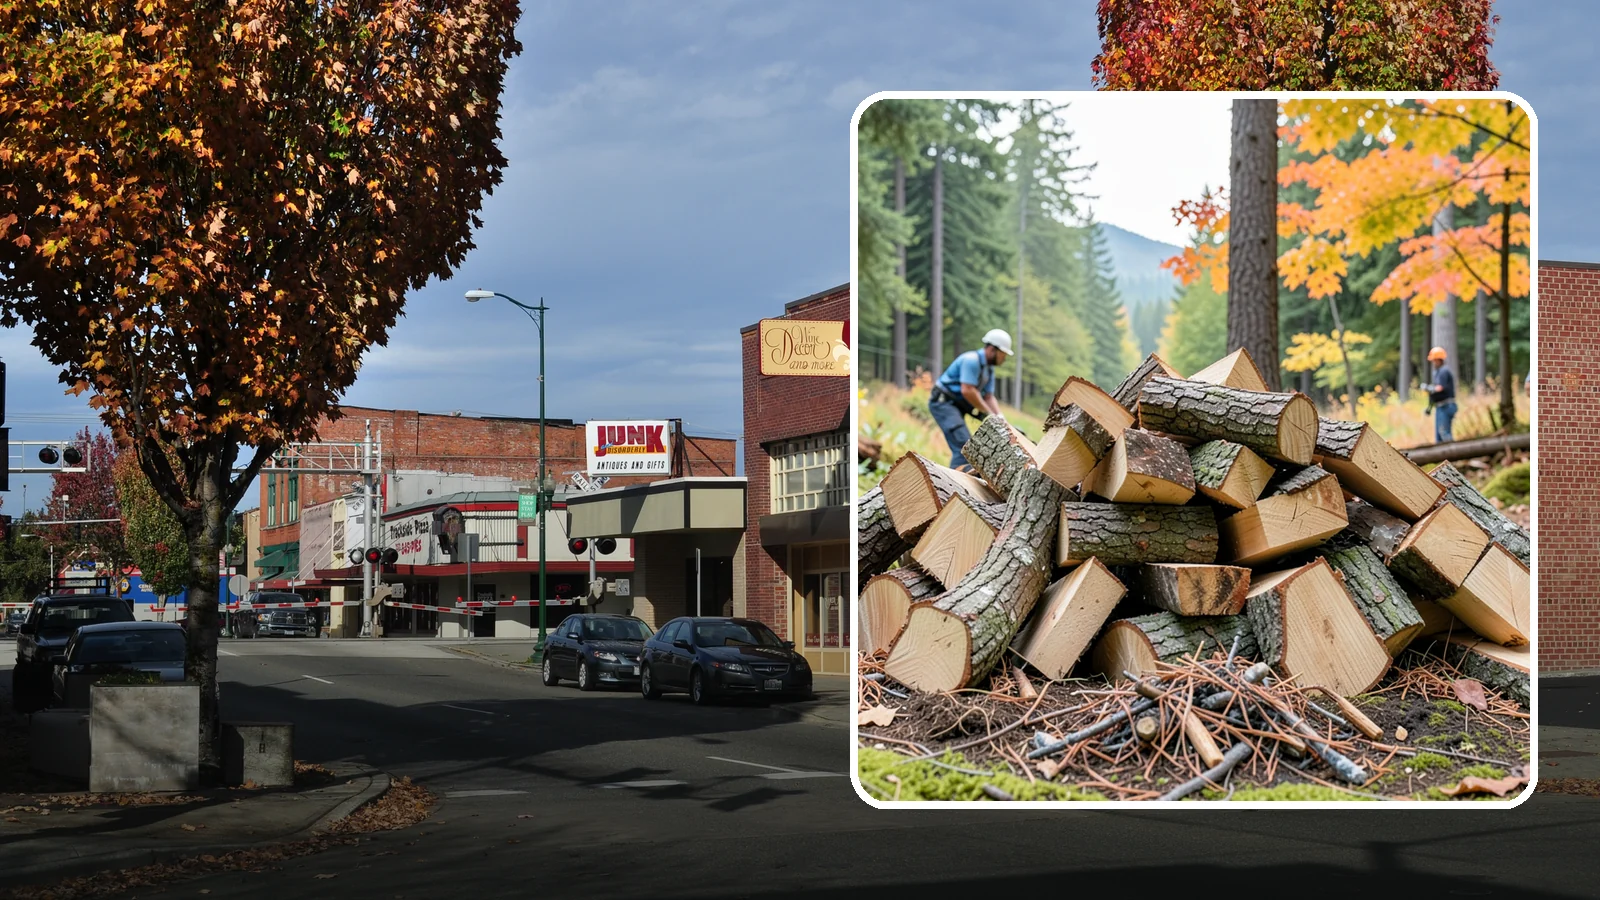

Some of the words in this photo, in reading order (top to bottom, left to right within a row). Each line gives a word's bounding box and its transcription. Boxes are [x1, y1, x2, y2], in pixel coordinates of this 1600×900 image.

[596, 425, 664, 457] JUNK
[607, 446, 646, 454] DISORDERLY
[597, 461, 628, 470] ANTIQUES
[631, 461, 644, 469] AND
[647, 460, 665, 469] GIFTS
